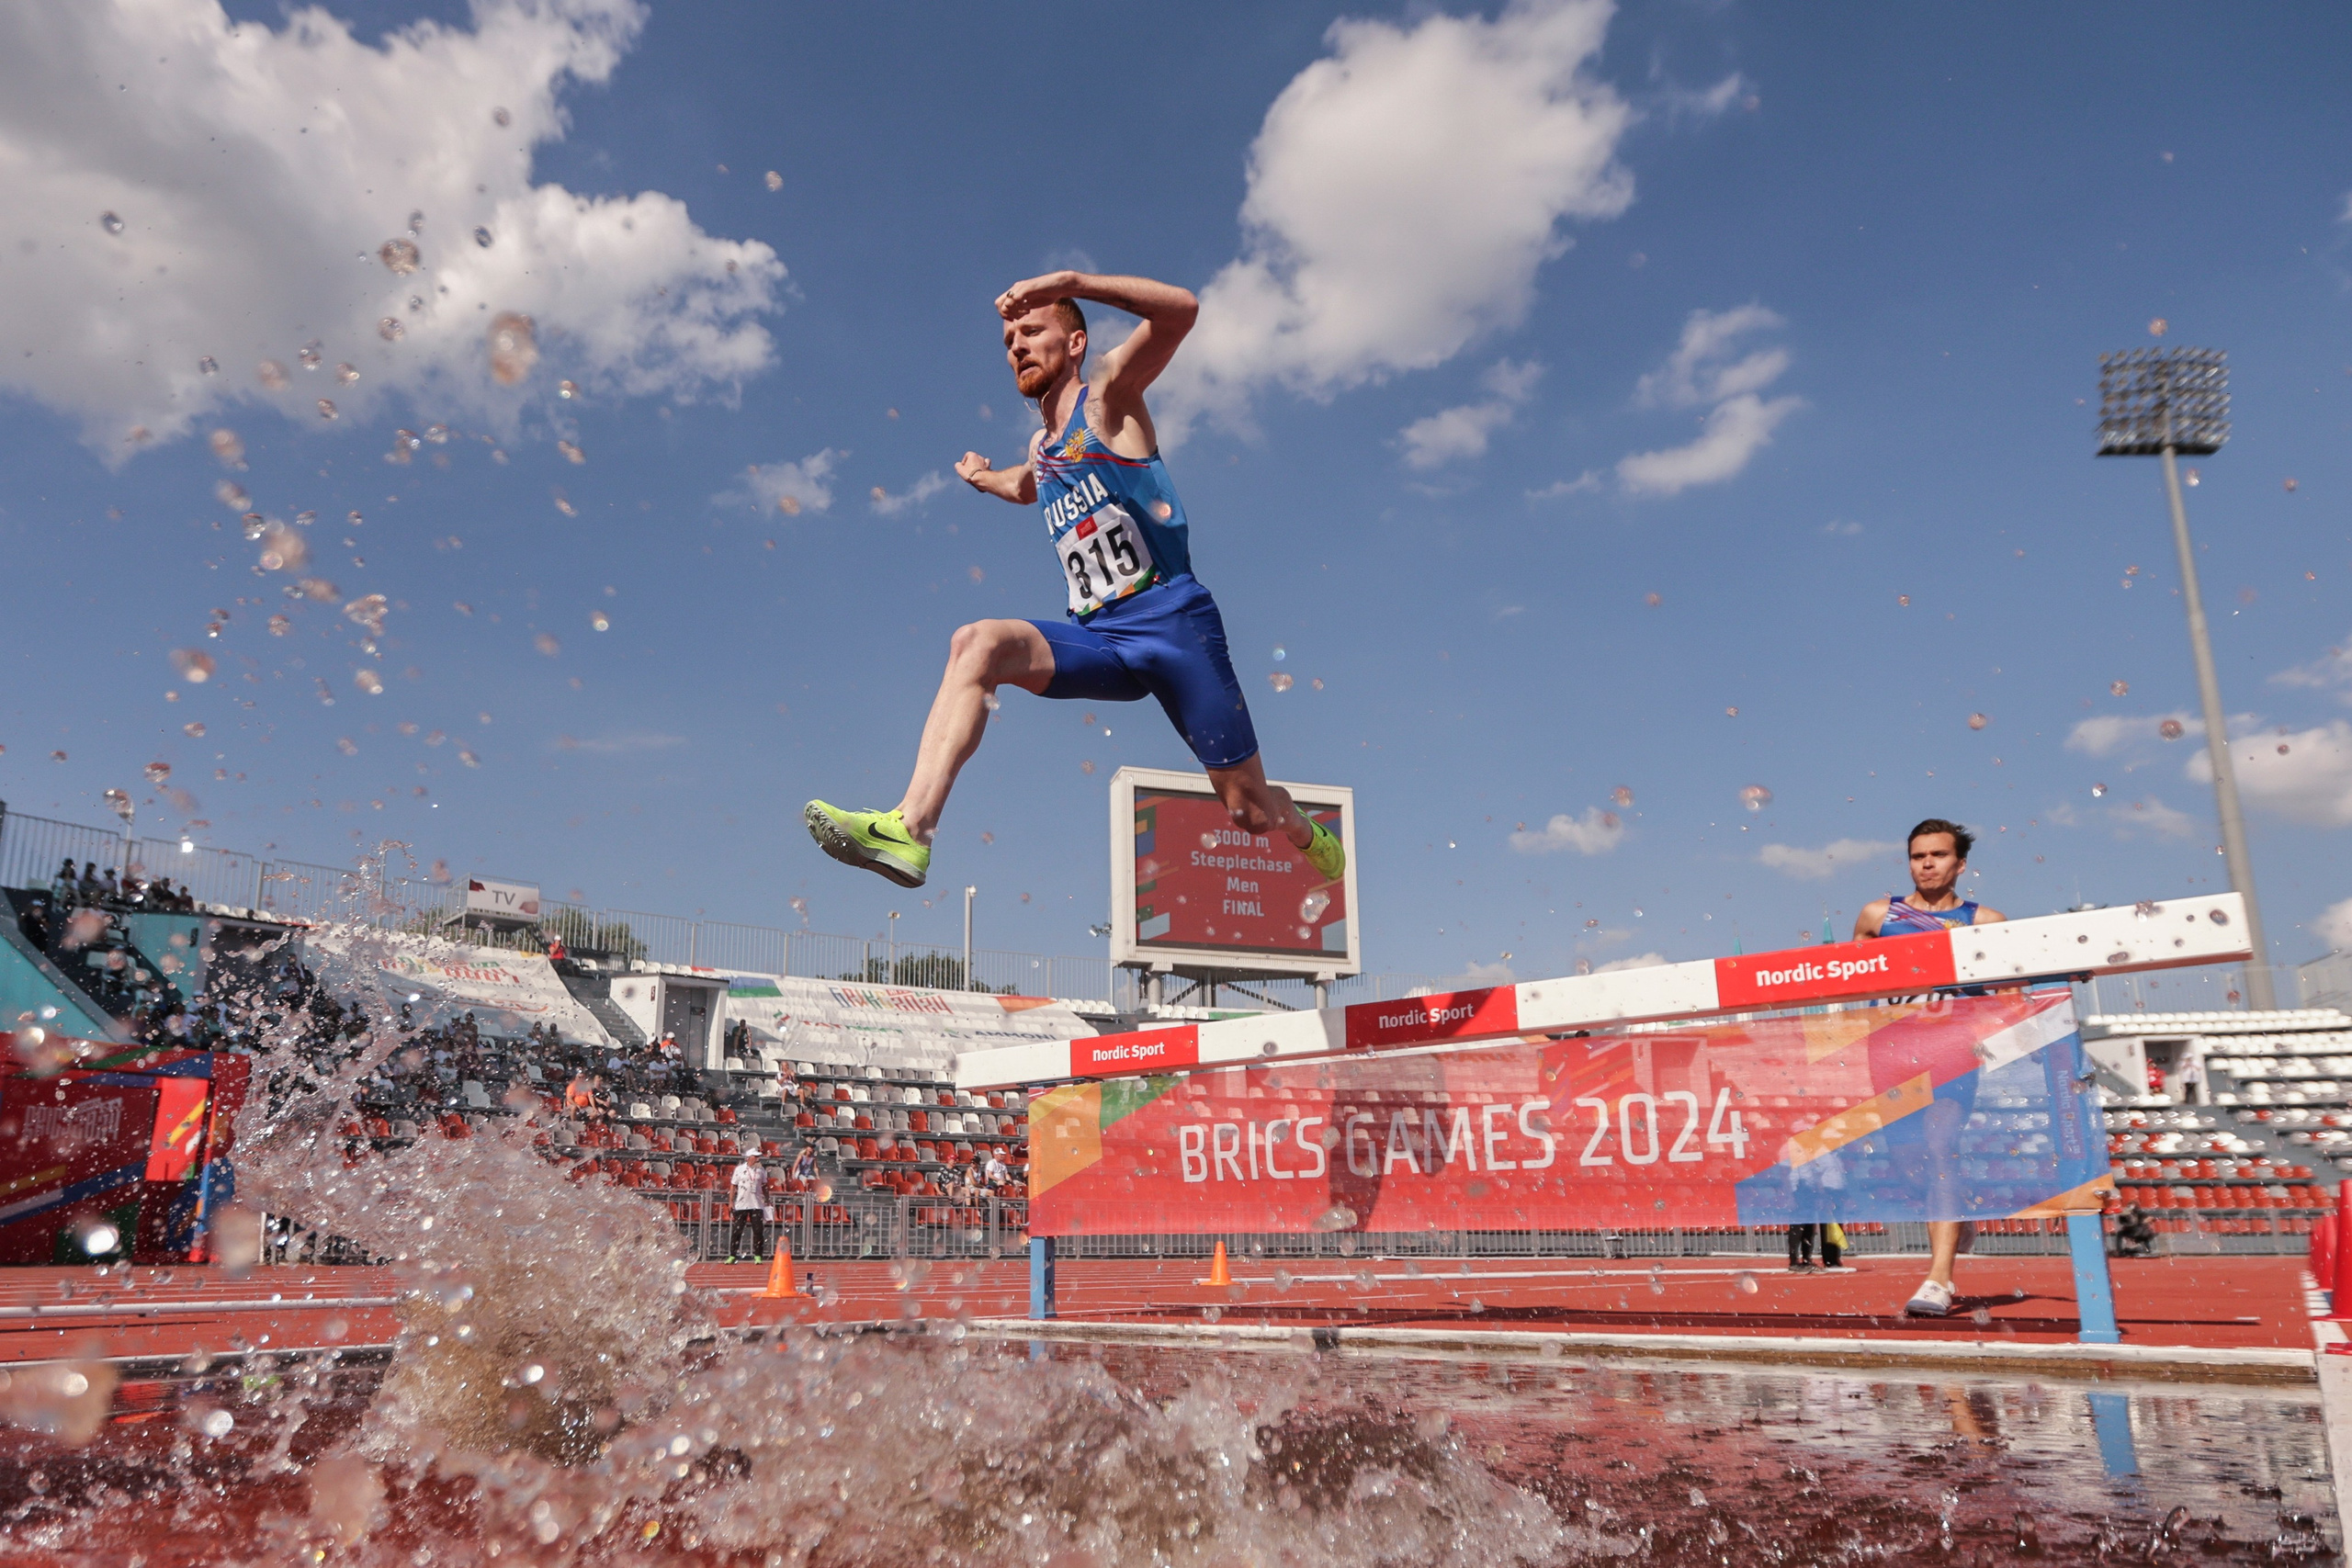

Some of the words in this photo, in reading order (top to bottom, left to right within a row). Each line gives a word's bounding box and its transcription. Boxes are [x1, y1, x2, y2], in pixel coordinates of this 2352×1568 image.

[1044, 472, 1109, 536] RUSSIA
[1068, 524, 1141, 600] 315
[1214, 829, 1251, 847] 3000
[1255, 835, 1270, 848] m
[1191, 851, 1292, 873] Steeplechase
[1227, 875, 1259, 894] Men
[492, 890, 515, 906] TV
[1223, 899, 1264, 918] FINAL
[1827, 953, 1889, 981] Sport
[1430, 1002, 1475, 1024] Sport
[1131, 1042, 1165, 1060] Sport
[1180, 1116, 1326, 1183] BRICS
[1346, 1100, 1555, 1176] GAMES
[1577, 1087, 1750, 1167] 2024
